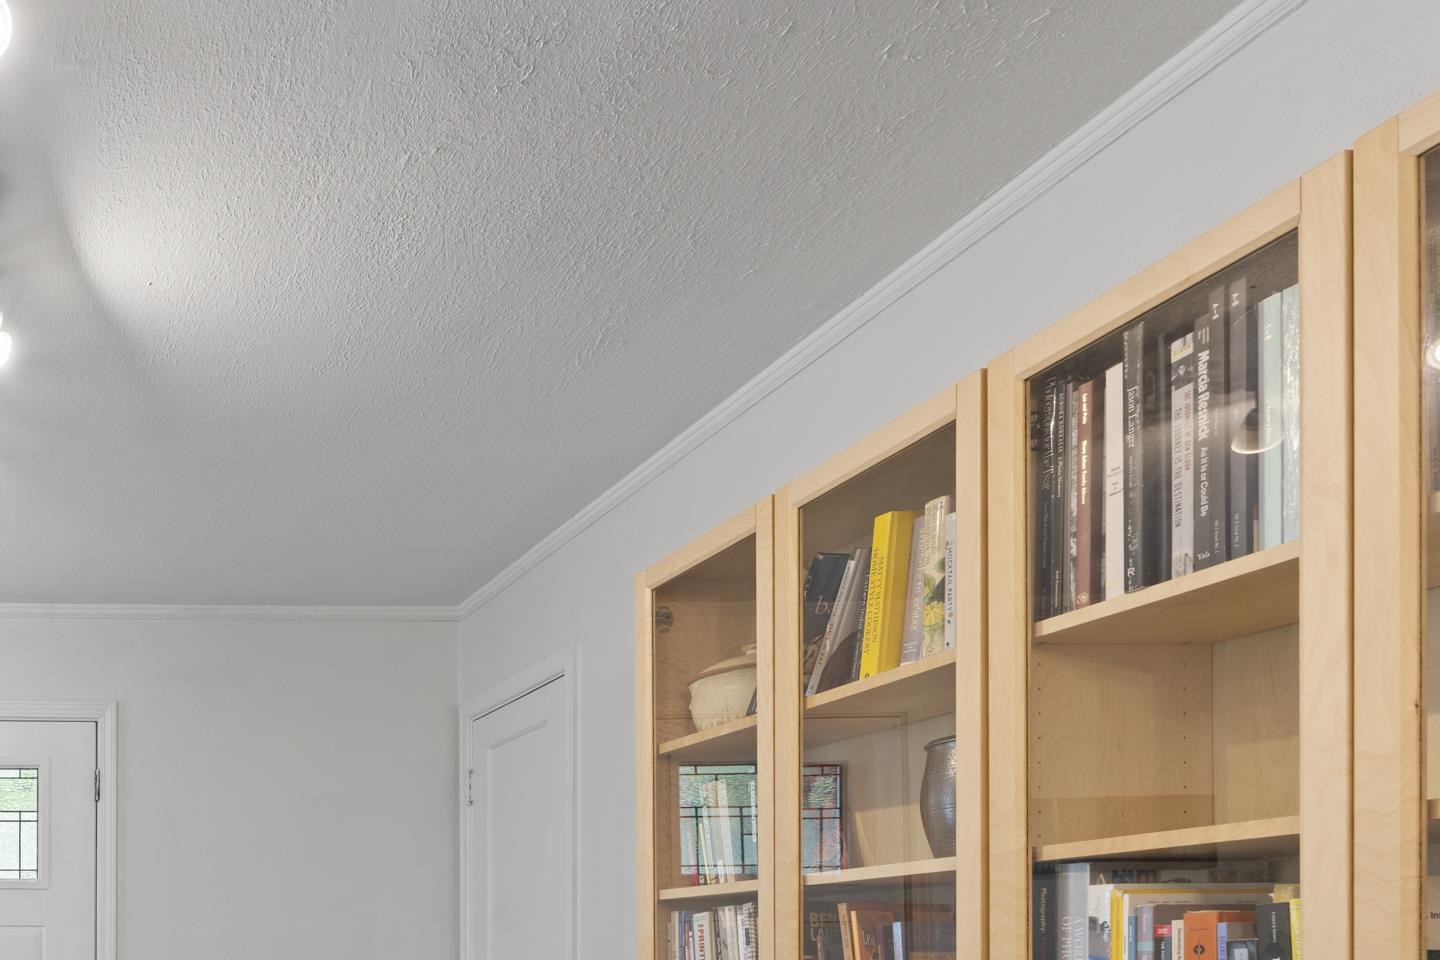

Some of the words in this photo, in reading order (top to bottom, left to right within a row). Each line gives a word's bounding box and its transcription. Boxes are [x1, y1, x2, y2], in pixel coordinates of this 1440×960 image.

[1198, 350, 1210, 391] Marcia
[1127, 386, 1139, 413] Jason
[1174, 408, 1183, 419] THE
[1198, 391, 1210, 441] Resnick
[1127, 415, 1139, 449] Langer
[1174, 424, 1183, 454] JOURNEY
[1174, 456, 1183, 466] IS
[1200, 447, 1209, 457] As
[1174, 466, 1183, 480] THE
[1200, 463, 1209, 472] Is
[1200, 473, 1208, 481] or
[1174, 482, 1184, 529] DESTINATION
[1200, 481, 1209, 504] Could
[1200, 505, 1209, 517] Be
[870, 548, 879, 576] HOME
[875, 556, 885, 589] MATTY
[868, 579, 876, 608] STYLE
[857, 608, 866, 630] India
[872, 590, 882, 643] MATHESON
[863, 610, 873, 655] COOKERY
[1061, 916, 1071, 932] OF
